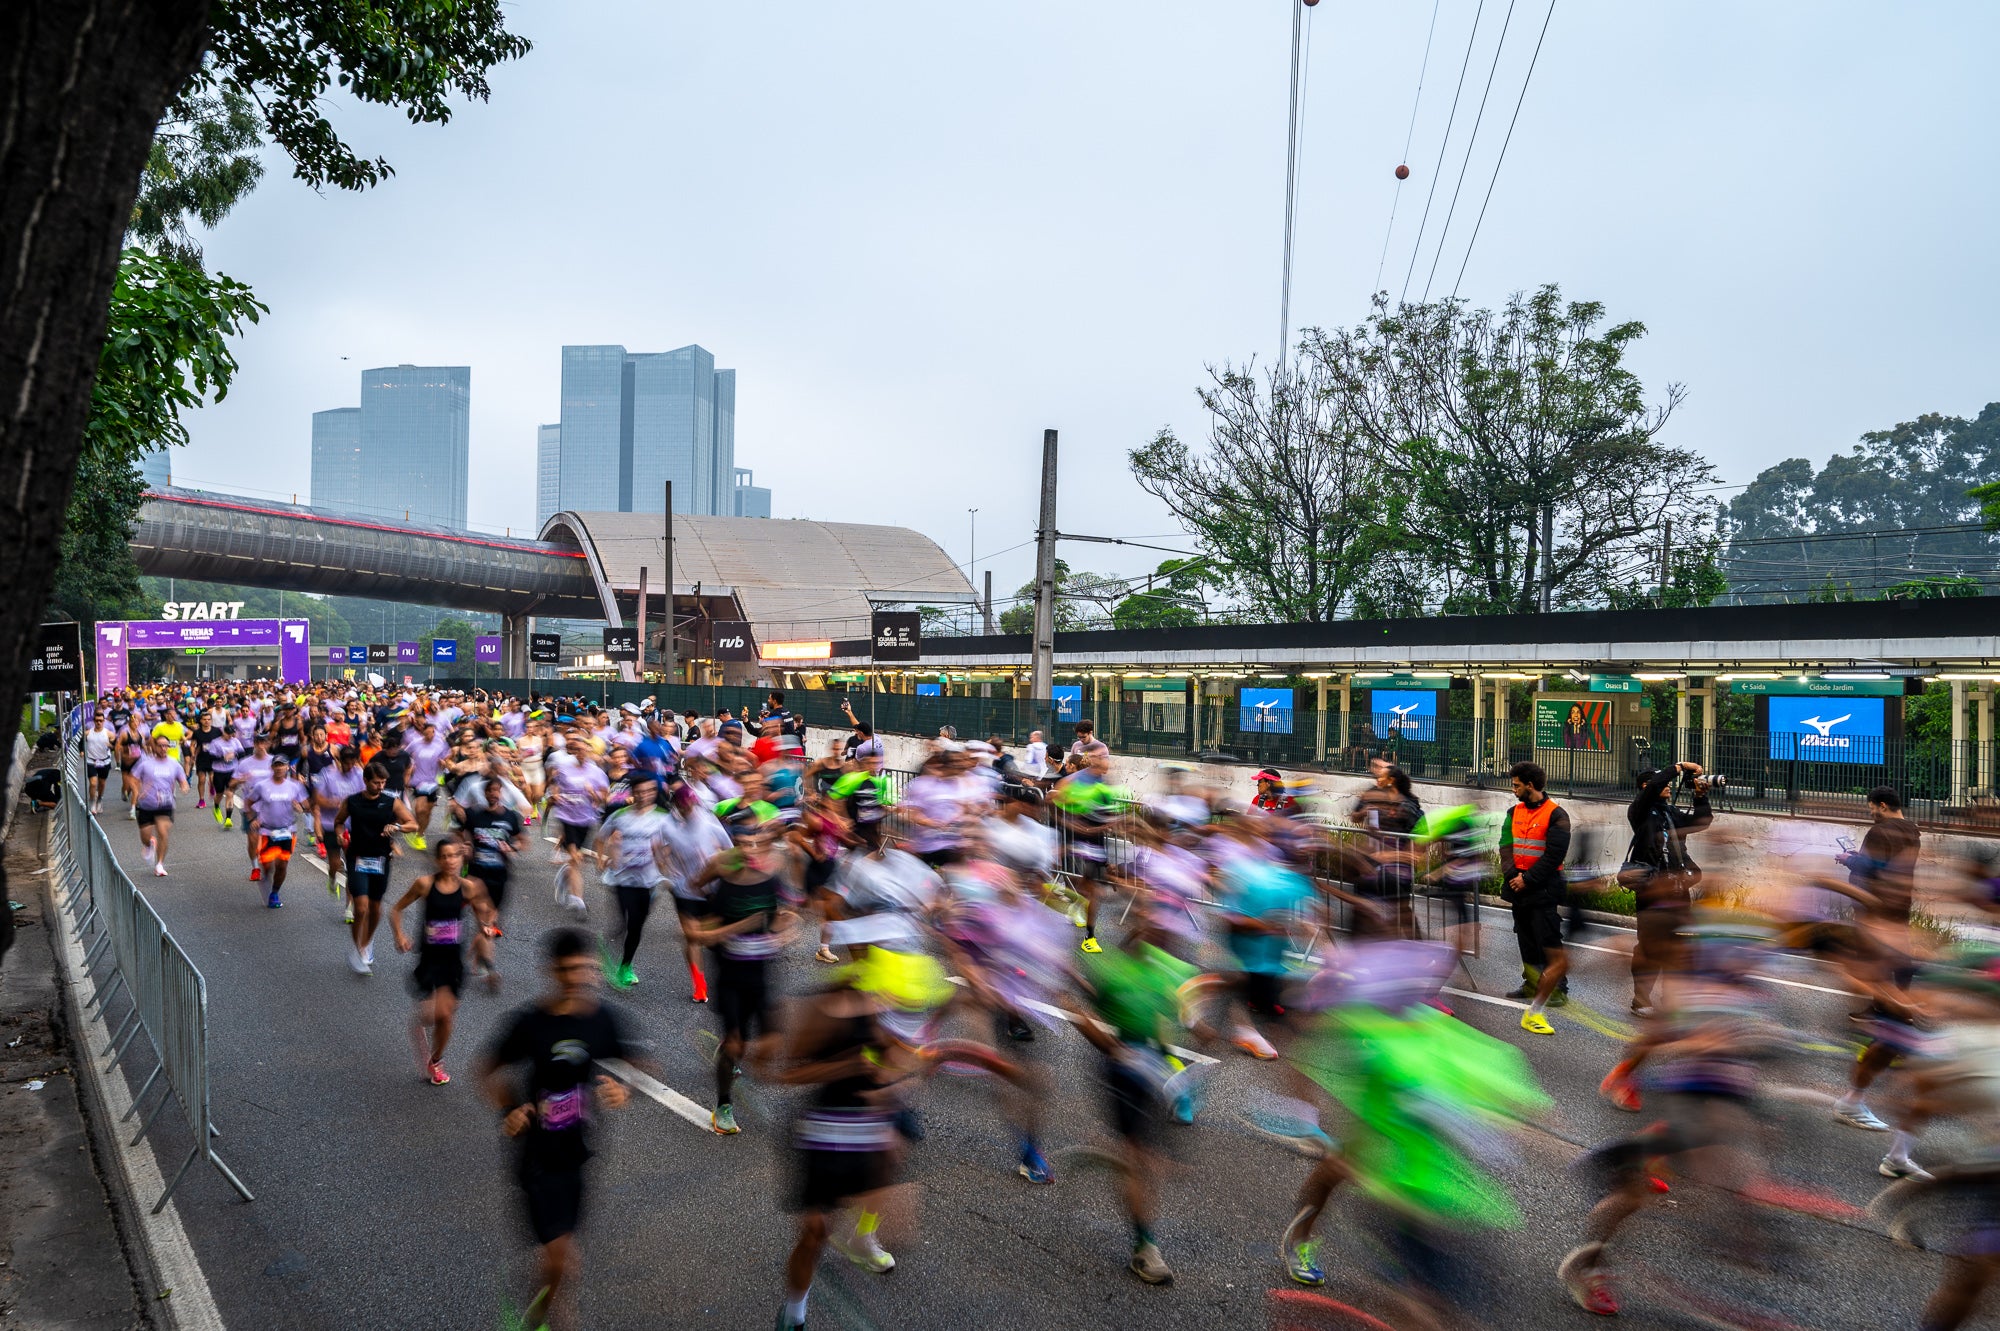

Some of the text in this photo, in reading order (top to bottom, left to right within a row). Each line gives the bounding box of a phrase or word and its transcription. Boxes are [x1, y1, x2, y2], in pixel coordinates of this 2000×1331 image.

[162, 602, 245, 620] START
[181, 628, 213, 636] ATHENAS
[46, 644, 64, 652] mais
[46, 662, 74, 670] corrida
